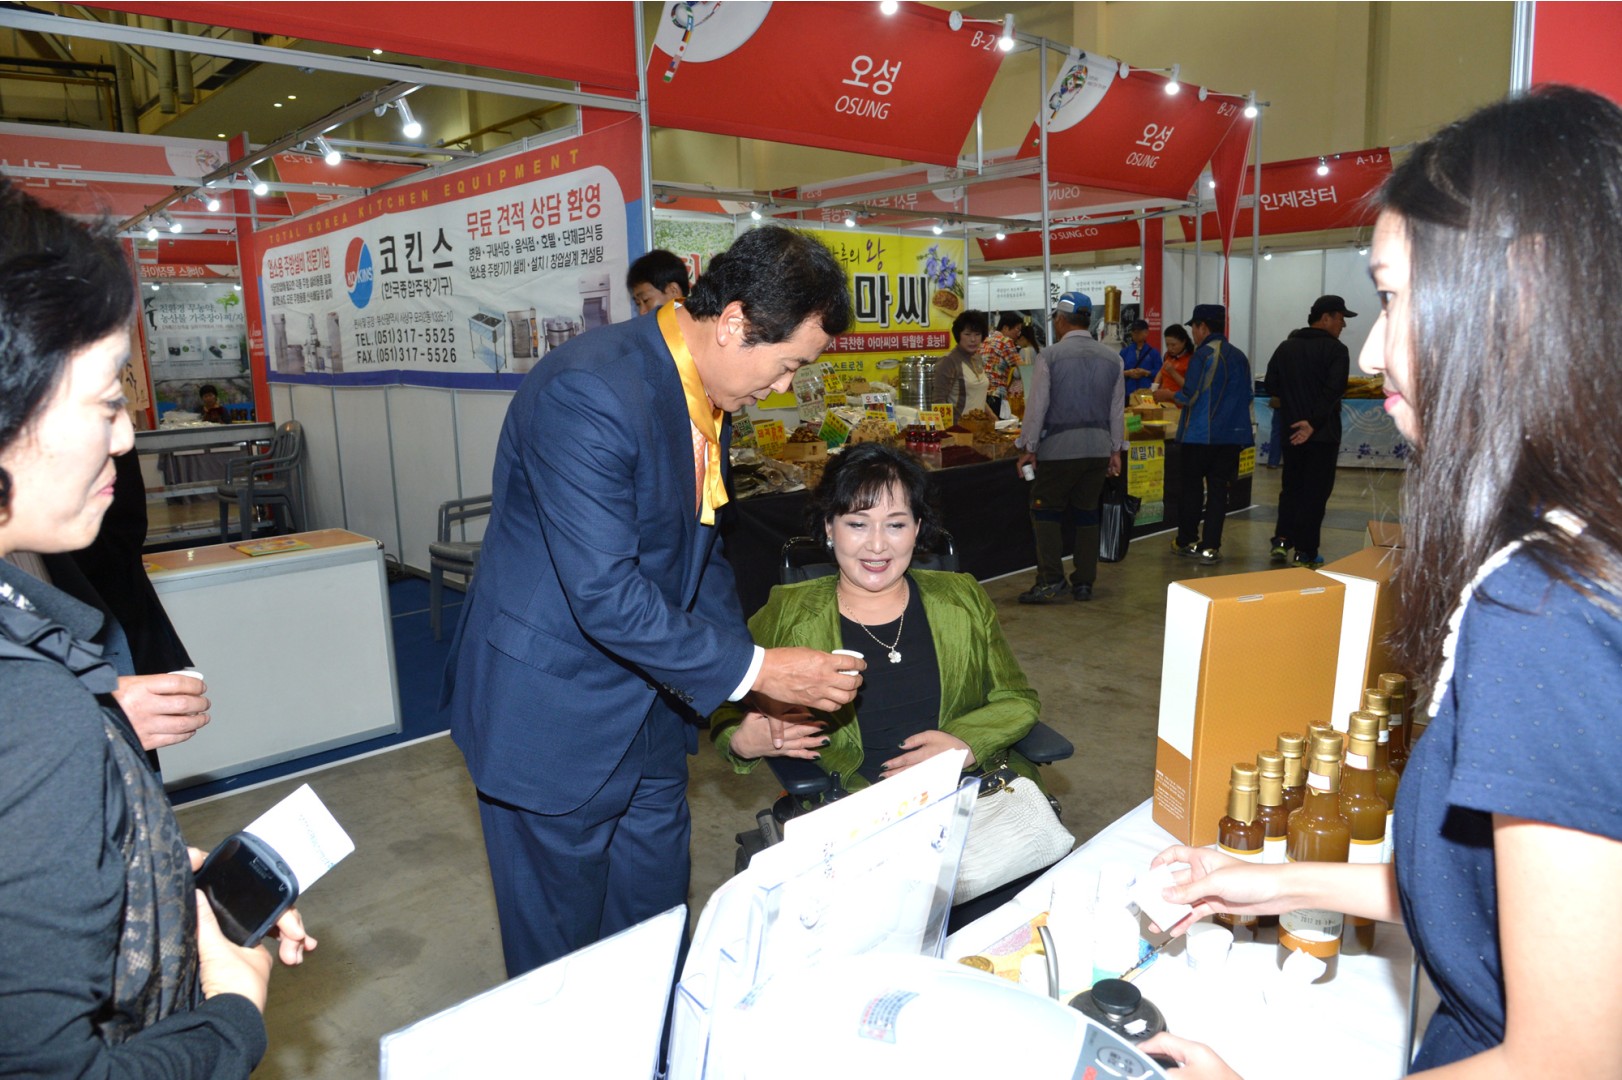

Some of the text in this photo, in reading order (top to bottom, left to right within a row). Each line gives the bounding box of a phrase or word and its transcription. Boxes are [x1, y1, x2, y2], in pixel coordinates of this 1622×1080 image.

[842, 54, 902, 96] 오성
[834, 95, 891, 120] OSUNG
[1216, 102, 1237, 117] B-21
[1135, 123, 1175, 152] 오성
[1125, 151, 1160, 169] OSUNG
[1356, 153, 1383, 166] A-12
[269, 227, 300, 244] TOTAL
[308, 213, 348, 232] KOREA
[358, 190, 428, 219] KITCHEN
[444, 149, 579, 196] EQUIPMENT
[1260, 185, 1338, 211] 인제장터
[467, 183, 601, 241] 무료 견적 상담 환영
[469, 223, 603, 262] 병원 구내식당 음식점 호텔 단체급식 등
[1085, 227, 1098, 237] CO
[379, 228, 454, 275] 코킨스
[469, 246, 604, 280] 업소용 주방기기 설비 설치 창업설계 컨설팅
[866, 238, 886, 271] 왕
[382, 276, 453, 300] (한국종합주방기구)
[839, 337, 865, 350] 극찬한
[868, 336, 899, 349] 아마씨의
[902, 335, 924, 348] 탁월한
[927, 334, 946, 348] 효능!!
